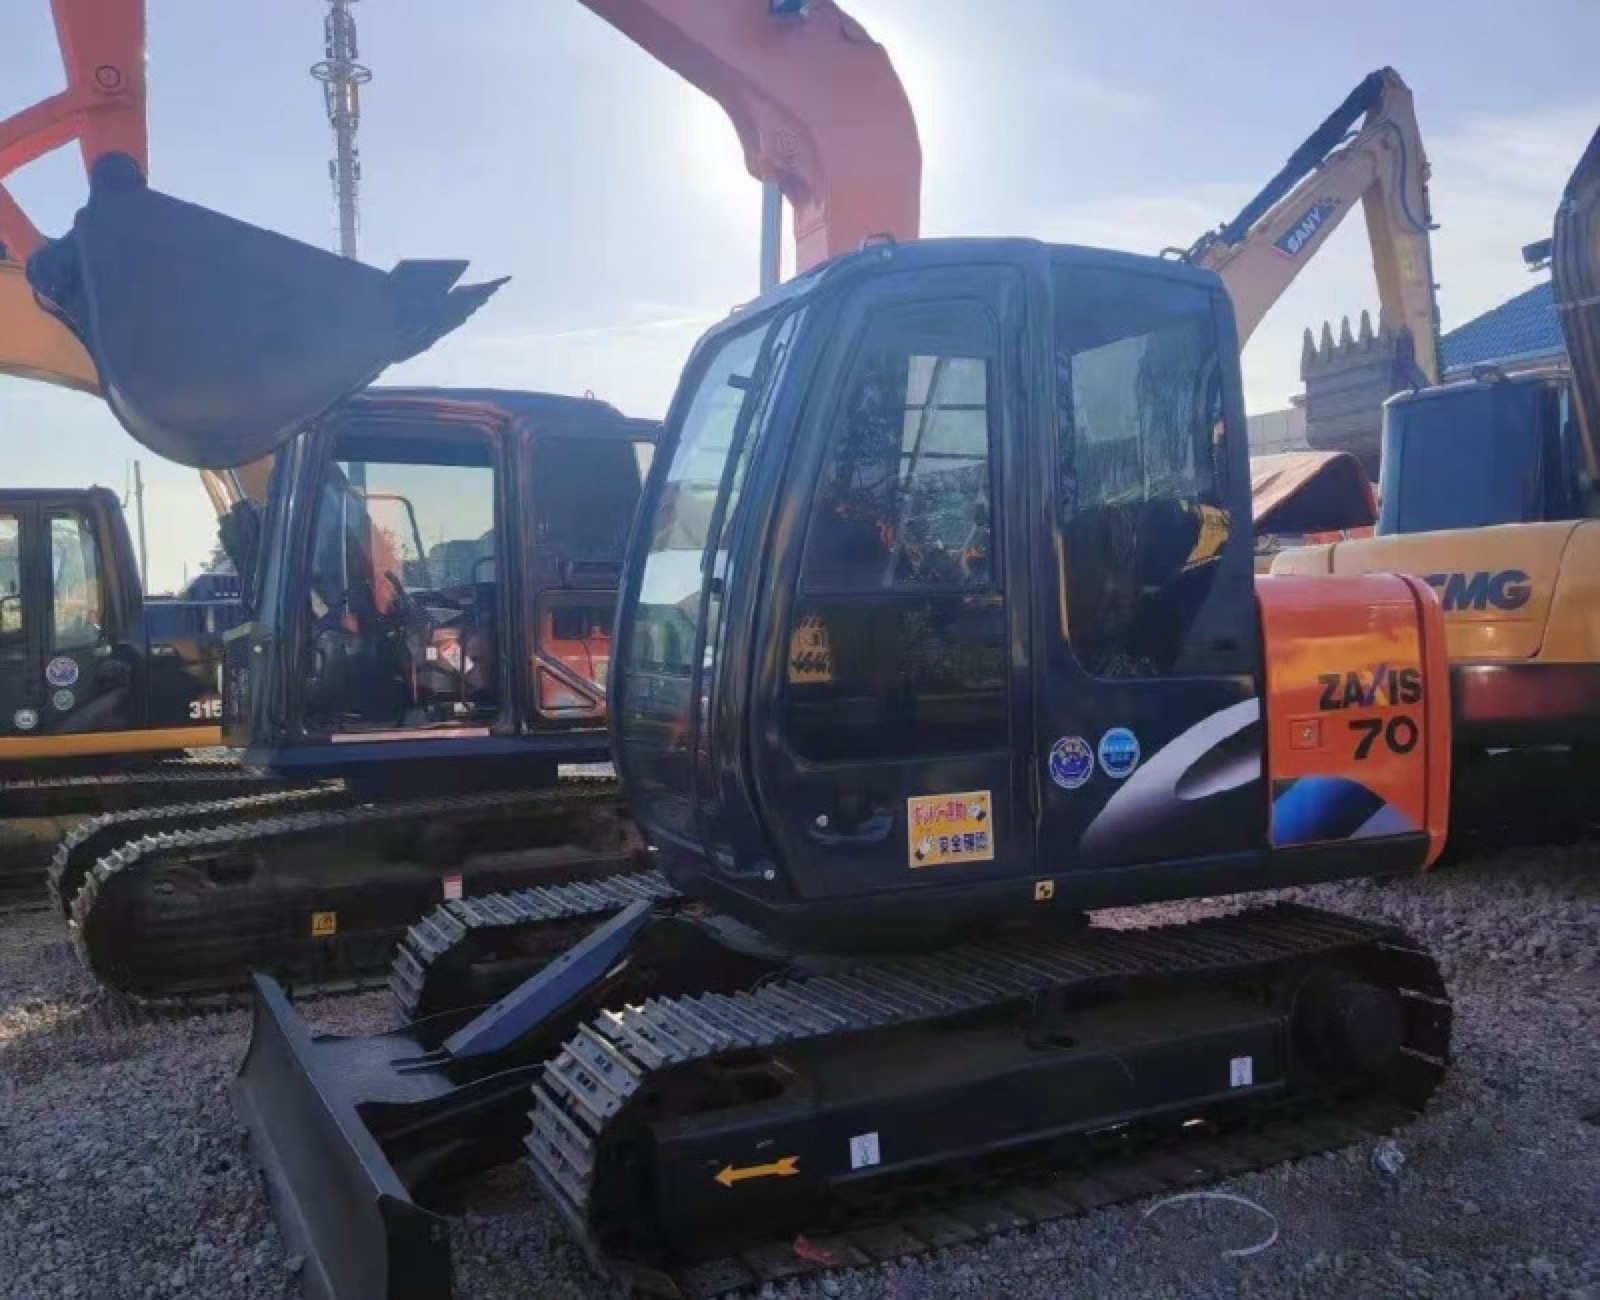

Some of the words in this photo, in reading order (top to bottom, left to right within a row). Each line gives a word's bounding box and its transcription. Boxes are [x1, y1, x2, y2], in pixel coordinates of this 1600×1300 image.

[1287, 206, 1322, 253] SANY
[189, 700, 223, 719] 315
[1318, 663, 1422, 711] ZAXIS
[1349, 715, 1419, 761] 70
